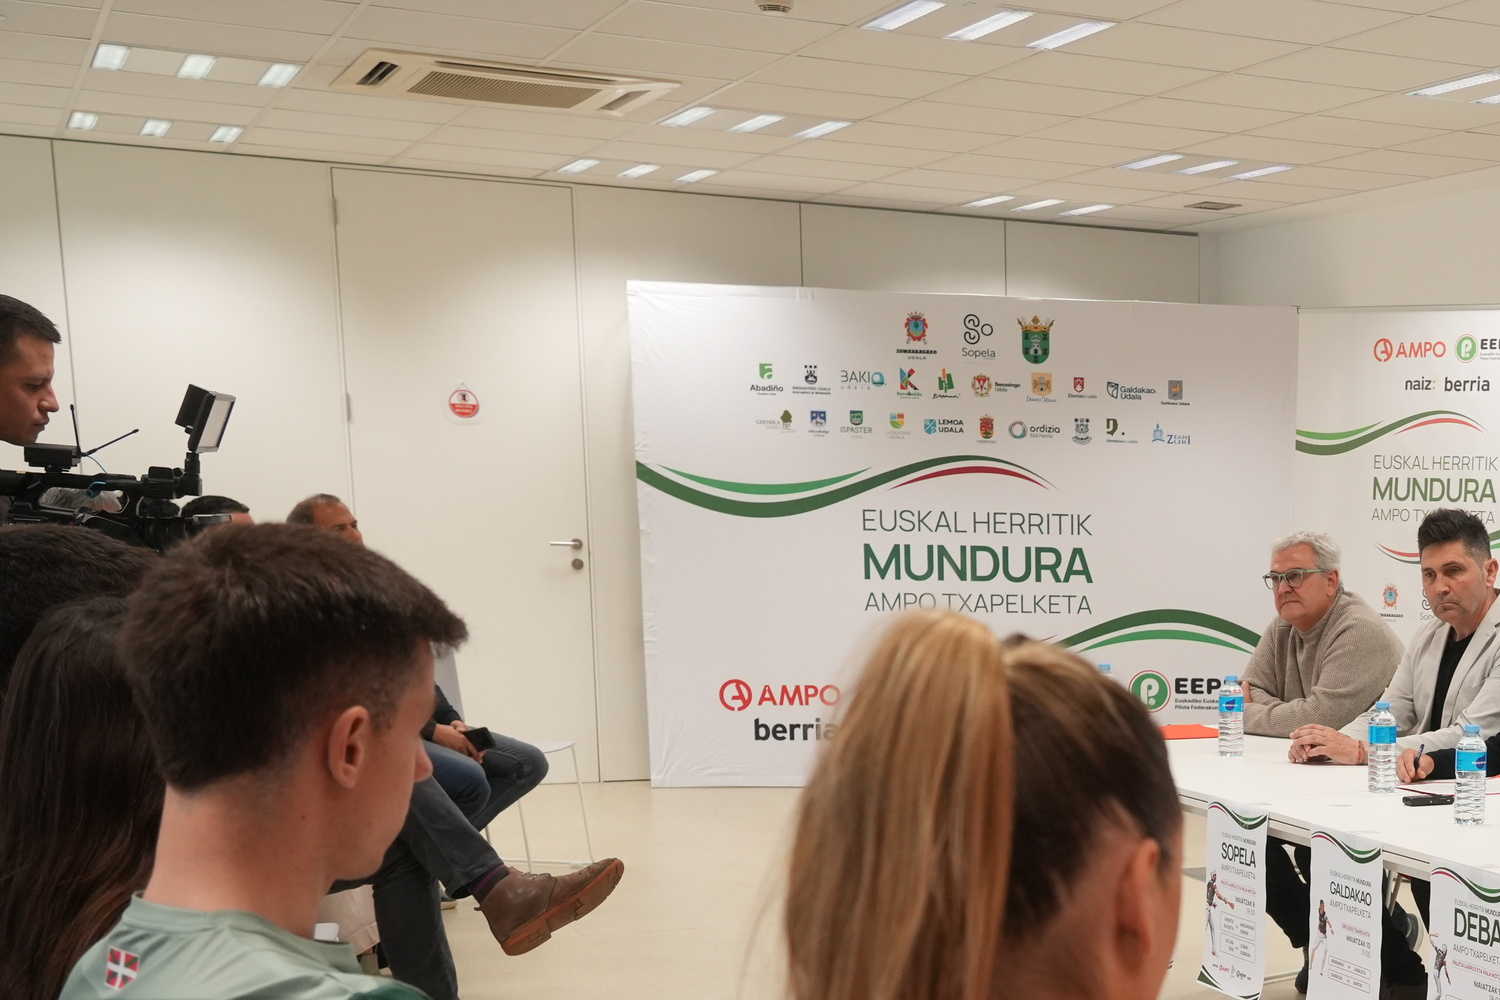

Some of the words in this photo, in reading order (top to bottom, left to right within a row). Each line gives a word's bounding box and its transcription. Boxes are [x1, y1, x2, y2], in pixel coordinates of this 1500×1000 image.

[962, 347, 996, 360] Sopela
[1396, 341, 1446, 358] AMPO
[750, 384, 784, 392] Abadiño
[1444, 376, 1490, 392] berria
[840, 426, 873, 434] ISPASTER
[1029, 424, 1061, 433] ordizia
[1374, 454, 1429, 470] EUSKAL
[1432, 455, 1498, 471] HERRITIK
[1372, 476, 1497, 503] MUNDURA
[862, 509, 967, 533] EUSKAL
[972, 511, 1092, 536] HERRITIK
[1371, 508, 1411, 522] AMPO
[863, 543, 1093, 583] MUNDURA
[864, 592, 937, 611] AMPO
[941, 593, 1091, 614] TXAPELKETA
[1175, 678, 1225, 694] EEP
[758, 685, 841, 706] AMPO
[1221, 842, 1256, 868] SOPELA
[1330, 881, 1372, 907] GALDAKAO
[1330, 899, 1343, 910] AMPO
[1344, 903, 1371, 920] TXAPELKETA
[1453, 943, 1469, 956] AMPO
[1473, 980, 1498, 994] MAIATZAK
